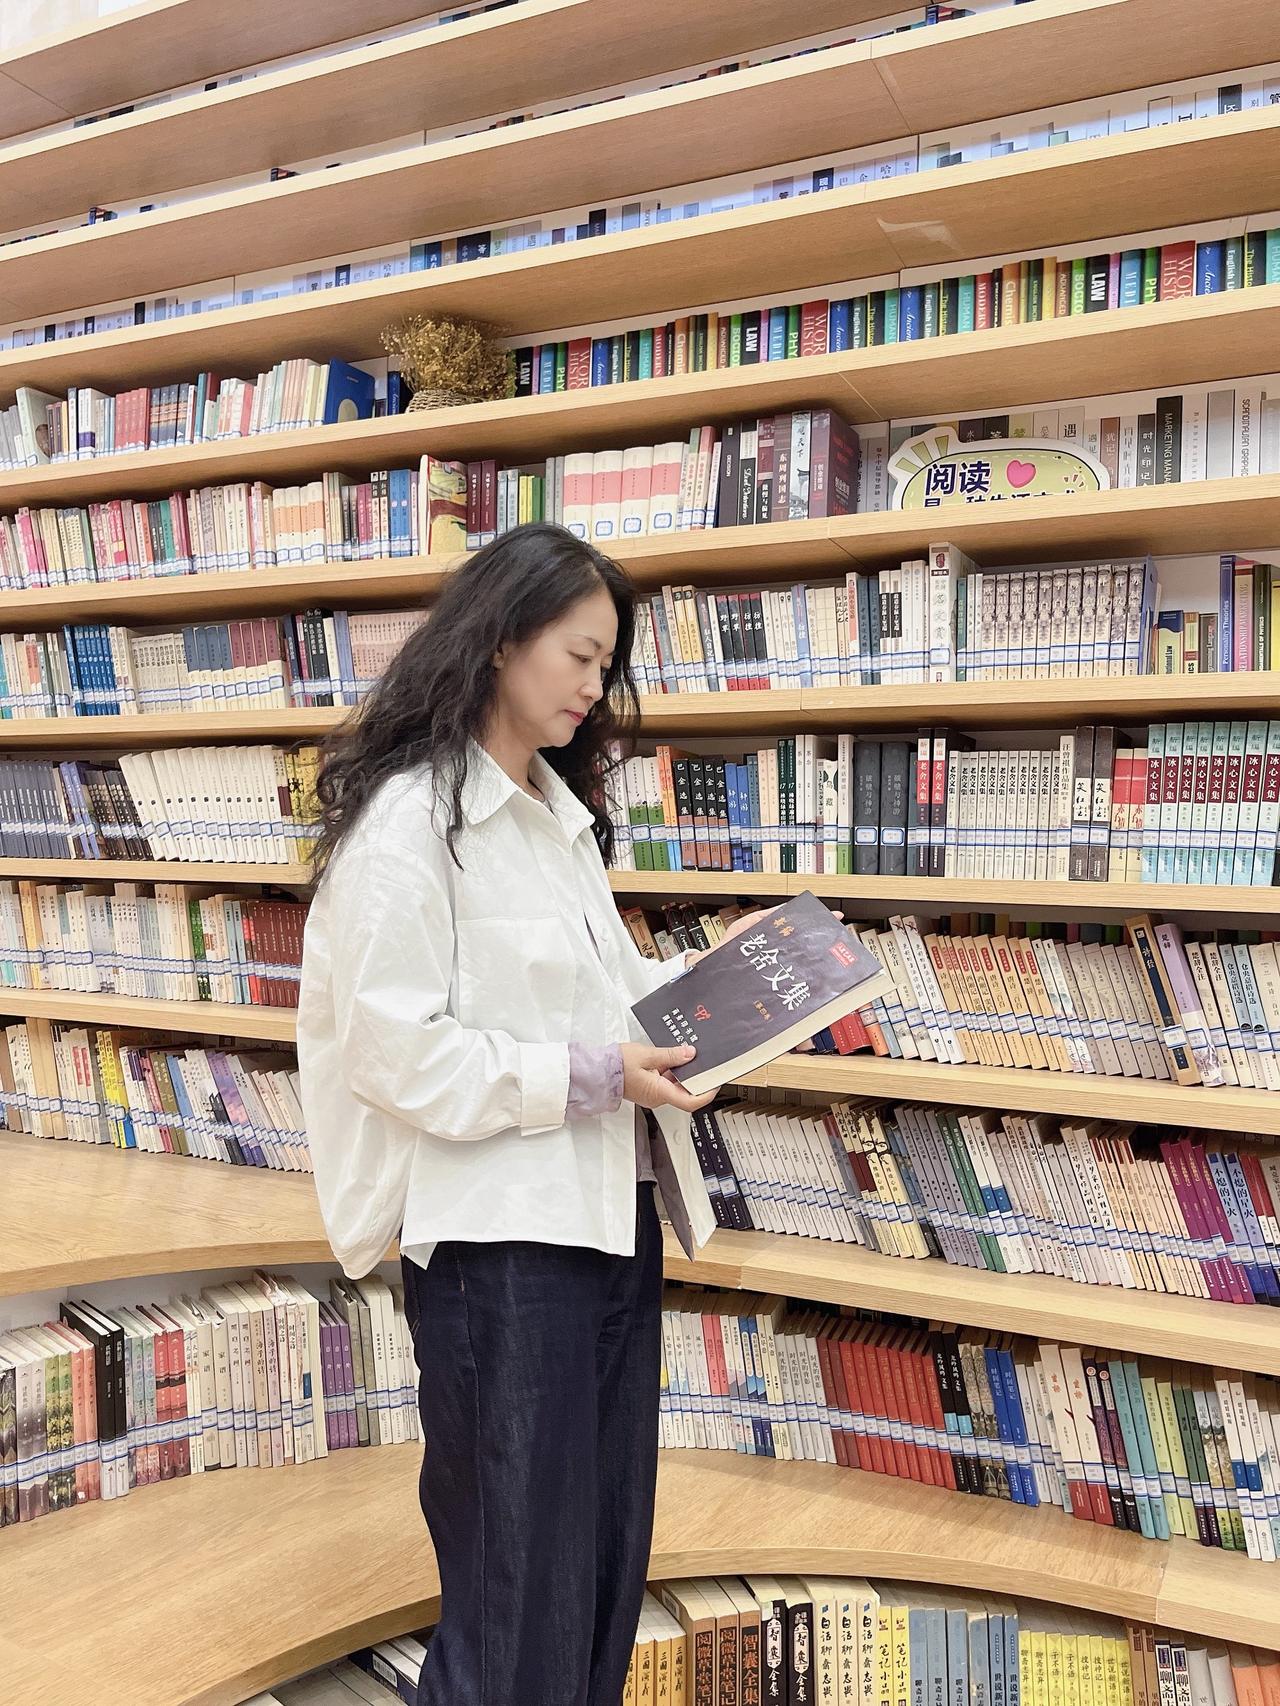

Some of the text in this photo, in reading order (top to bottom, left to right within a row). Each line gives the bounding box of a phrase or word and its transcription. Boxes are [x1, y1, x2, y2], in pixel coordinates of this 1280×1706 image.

[1226, 250, 1235, 279] English
[977, 282, 986, 328] MODERN
[1058, 273, 1067, 315] ADVANCED
[1091, 273, 1106, 301] LAW
[853, 306, 861, 333] English
[888, 303, 897, 342] HUMAN
[961, 290, 969, 329] HUMAN
[746, 327, 758, 352] LAW
[788, 332, 799, 358] PHY
[520, 361, 531, 385] LAW
[556, 367, 565, 391] PHY
[1063, 423, 1077, 438] 遇
[1164, 412, 1173, 458] MARKETING
[778, 452, 788, 504] 东周列国志
[925, 460, 991, 495] 阅读
[1141, 431, 1154, 486] 时光印记
[720, 614, 730, 632] 野草
[731, 612, 741, 632] 野草
[744, 612, 754, 631] 彷徨
[753, 611, 763, 630] 彷徨
[704, 628, 714, 657] 狂人日记
[677, 763, 688, 815] 巴金选集
[692, 763, 705, 816] 巴金选集
[705, 764, 716, 816] 巴金选集
[716, 766, 727, 818] 巴金选集
[919, 761, 927, 800] 老舍文集
[935, 761, 943, 800] 老舍文集
[961, 767, 969, 795] 老舍文集
[969, 767, 977, 795] 老舍文集
[979, 766, 987, 795] 老舍文集
[1041, 766, 1049, 795] 老舍文集
[1150, 760, 1160, 801] 冰心文集
[1166, 758, 1177, 800] 冰心文集
[1182, 757, 1193, 799] 冰心文集
[1197, 758, 1207, 801] 冰心文集
[1211, 757, 1223, 799] 冰心文集
[1227, 757, 1239, 799] 冰心文集
[1246, 756, 1259, 799] 冰心文集
[1266, 756, 1280, 799] 冰心文集
[1141, 946, 1155, 969] 诗经
[1161, 933, 1171, 949] 楚辞
[739, 932, 811, 1011] 老舍文集
[1191, 952, 1206, 982] 楚辞全注
[1209, 952, 1223, 982] 楚辞全注
[1227, 963, 1243, 1004] 仓央嘉措诗选
[1241, 963, 1257, 1005] 仓央嘉措诗选
[672, 1007, 699, 1043] 商务印书馆
[1214, 1168, 1237, 1217] 不熄的星火
[1232, 1168, 1254, 1218] 不熄的星火
[256, 1341, 265, 1374] 海子的诗
[268, 1340, 277, 1374] 海子的诗
[641, 1650, 650, 1697] 三国演义
[659, 1651, 668, 1697] 三国演义
[674, 1646, 683, 1692] 三国演义
[697, 1633, 712, 1706] 阅微草堂笔记
[720, 1629, 736, 1706] 阅微草堂笔记
[743, 1634, 758, 1705] 智囊全集
[768, 1628, 780, 1697] 智囊全集
[796, 1633, 807, 1702] 智囊全集
[1021, 1649, 1029, 1682] 聊斋志异
[1035, 1651, 1044, 1684] 聊斋志异
[1050, 1653, 1060, 1676] 子不语
[1066, 1653, 1075, 1678] 子不语
[1080, 1655, 1089, 1680] 搜神记
[1094, 1656, 1103, 1681] 搜神记
[1107, 1657, 1116, 1691] 世说新语
[1120, 1661, 1130, 1694] 世说新语
